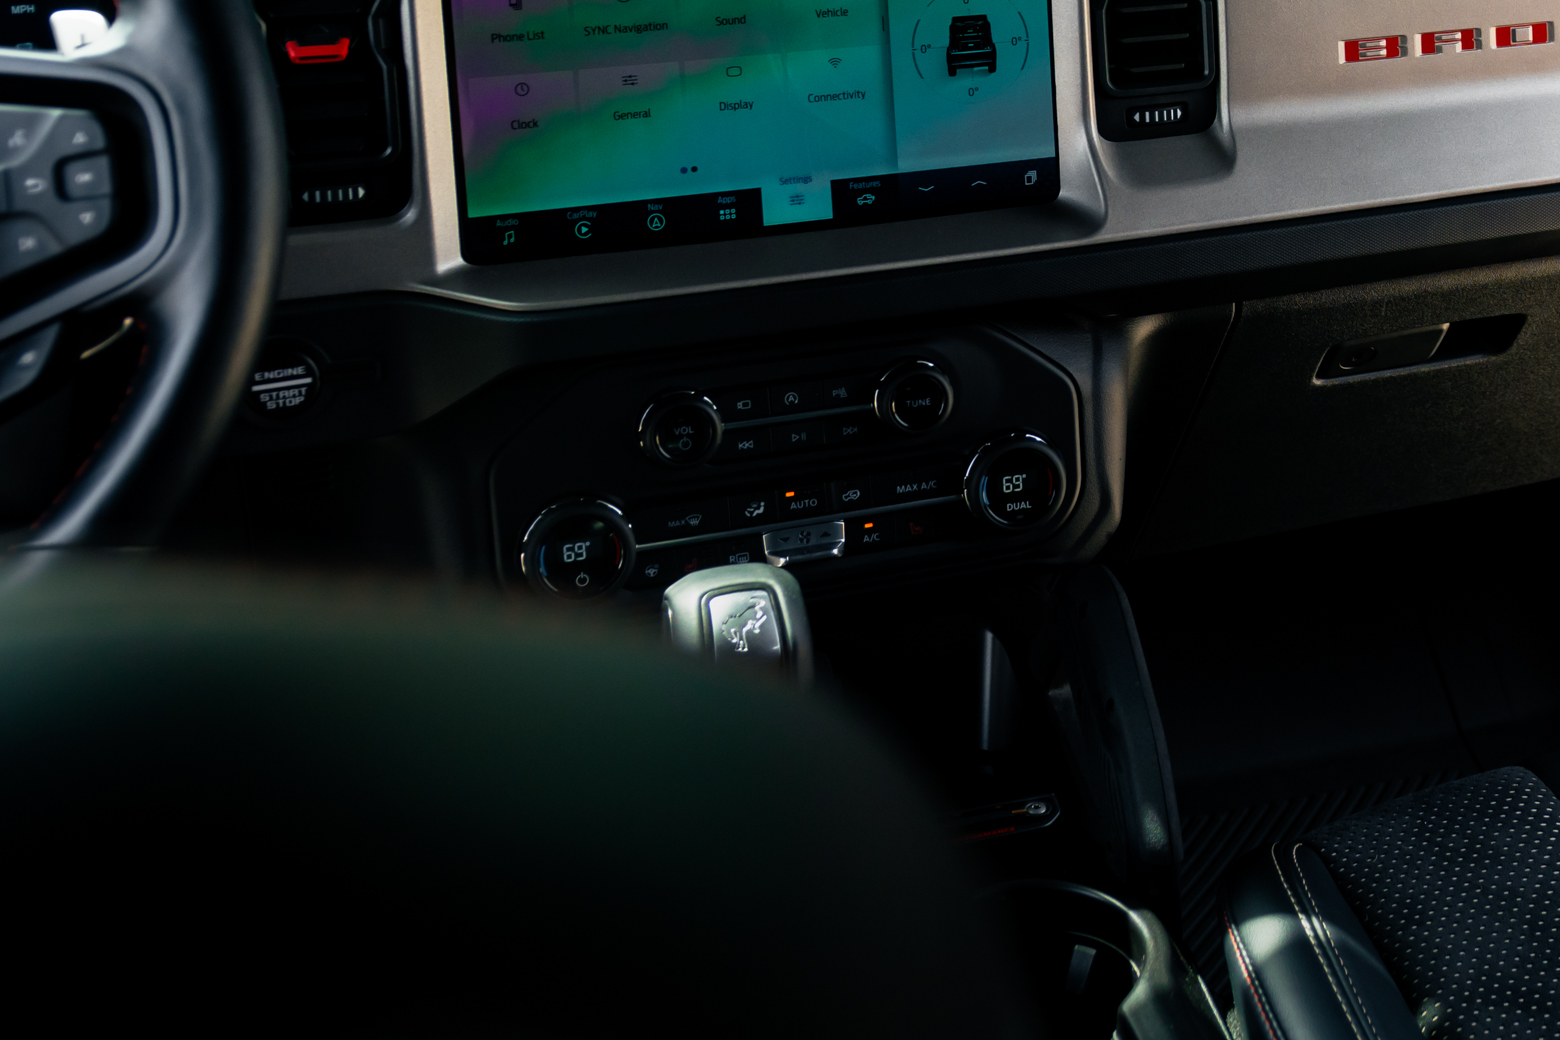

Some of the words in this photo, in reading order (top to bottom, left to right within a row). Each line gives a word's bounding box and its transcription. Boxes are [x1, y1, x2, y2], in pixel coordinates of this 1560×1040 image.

[11, 4, 35, 14] MPH
[815, 7, 849, 18] Vehicle
[715, 15, 747, 26] Sound
[583, 25, 612, 37] SYNC
[614, 21, 669, 35] Navigation
[490, 32, 523, 43] Phone
[525, 30, 545, 41] List
[807, 89, 866, 104] Connectivity
[719, 99, 754, 112] Display
[613, 108, 651, 121] General
[510, 118, 539, 131] Clock
[779, 174, 813, 186] Settings
[849, 179, 881, 189] Features
[717, 194, 736, 204] Apps
[648, 202, 663, 210] Nav
[567, 209, 597, 220] CarPlay
[496, 216, 519, 227] Audio
[254, 366, 307, 381] ENGINE
[260, 387, 308, 402] START
[266, 396, 305, 410] STOP
[905, 397, 931, 408] TUNE
[673, 425, 695, 436] VOL
[896, 482, 918, 494] MAX
[920, 480, 937, 491] A/C
[1002, 473, 1027, 493] 69°
[790, 498, 818, 510] AUTO
[1006, 501, 1032, 511] DUAL
[668, 519, 686, 528] MAX
[863, 533, 880, 543] A/C
[563, 541, 590, 562] 69°
